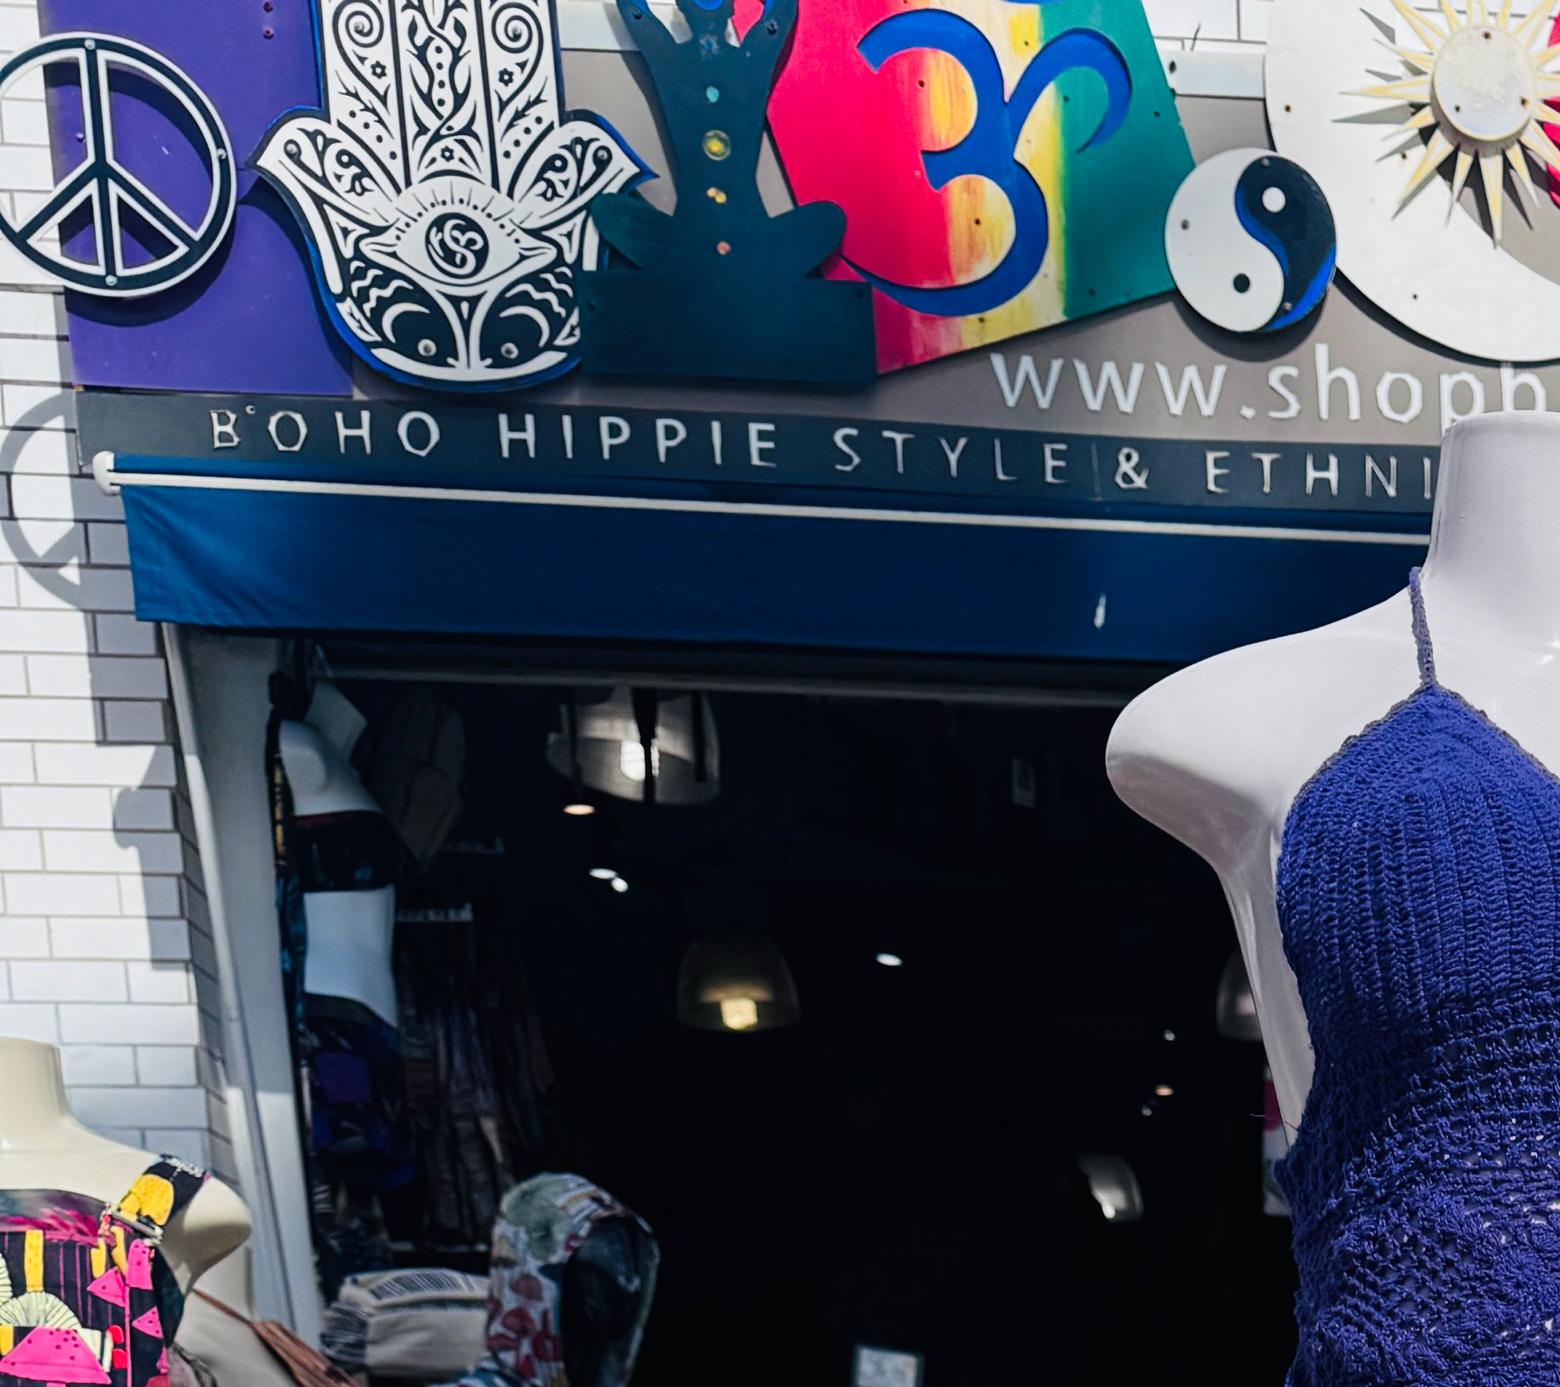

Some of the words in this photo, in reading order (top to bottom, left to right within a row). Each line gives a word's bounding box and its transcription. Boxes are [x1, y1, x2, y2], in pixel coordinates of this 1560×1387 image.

[210, 408, 441, 458] BOHO
[500, 412, 778, 470] HIPPIE
[833, 427, 1068, 485] STYLE
[1115, 445, 1149, 492] &
